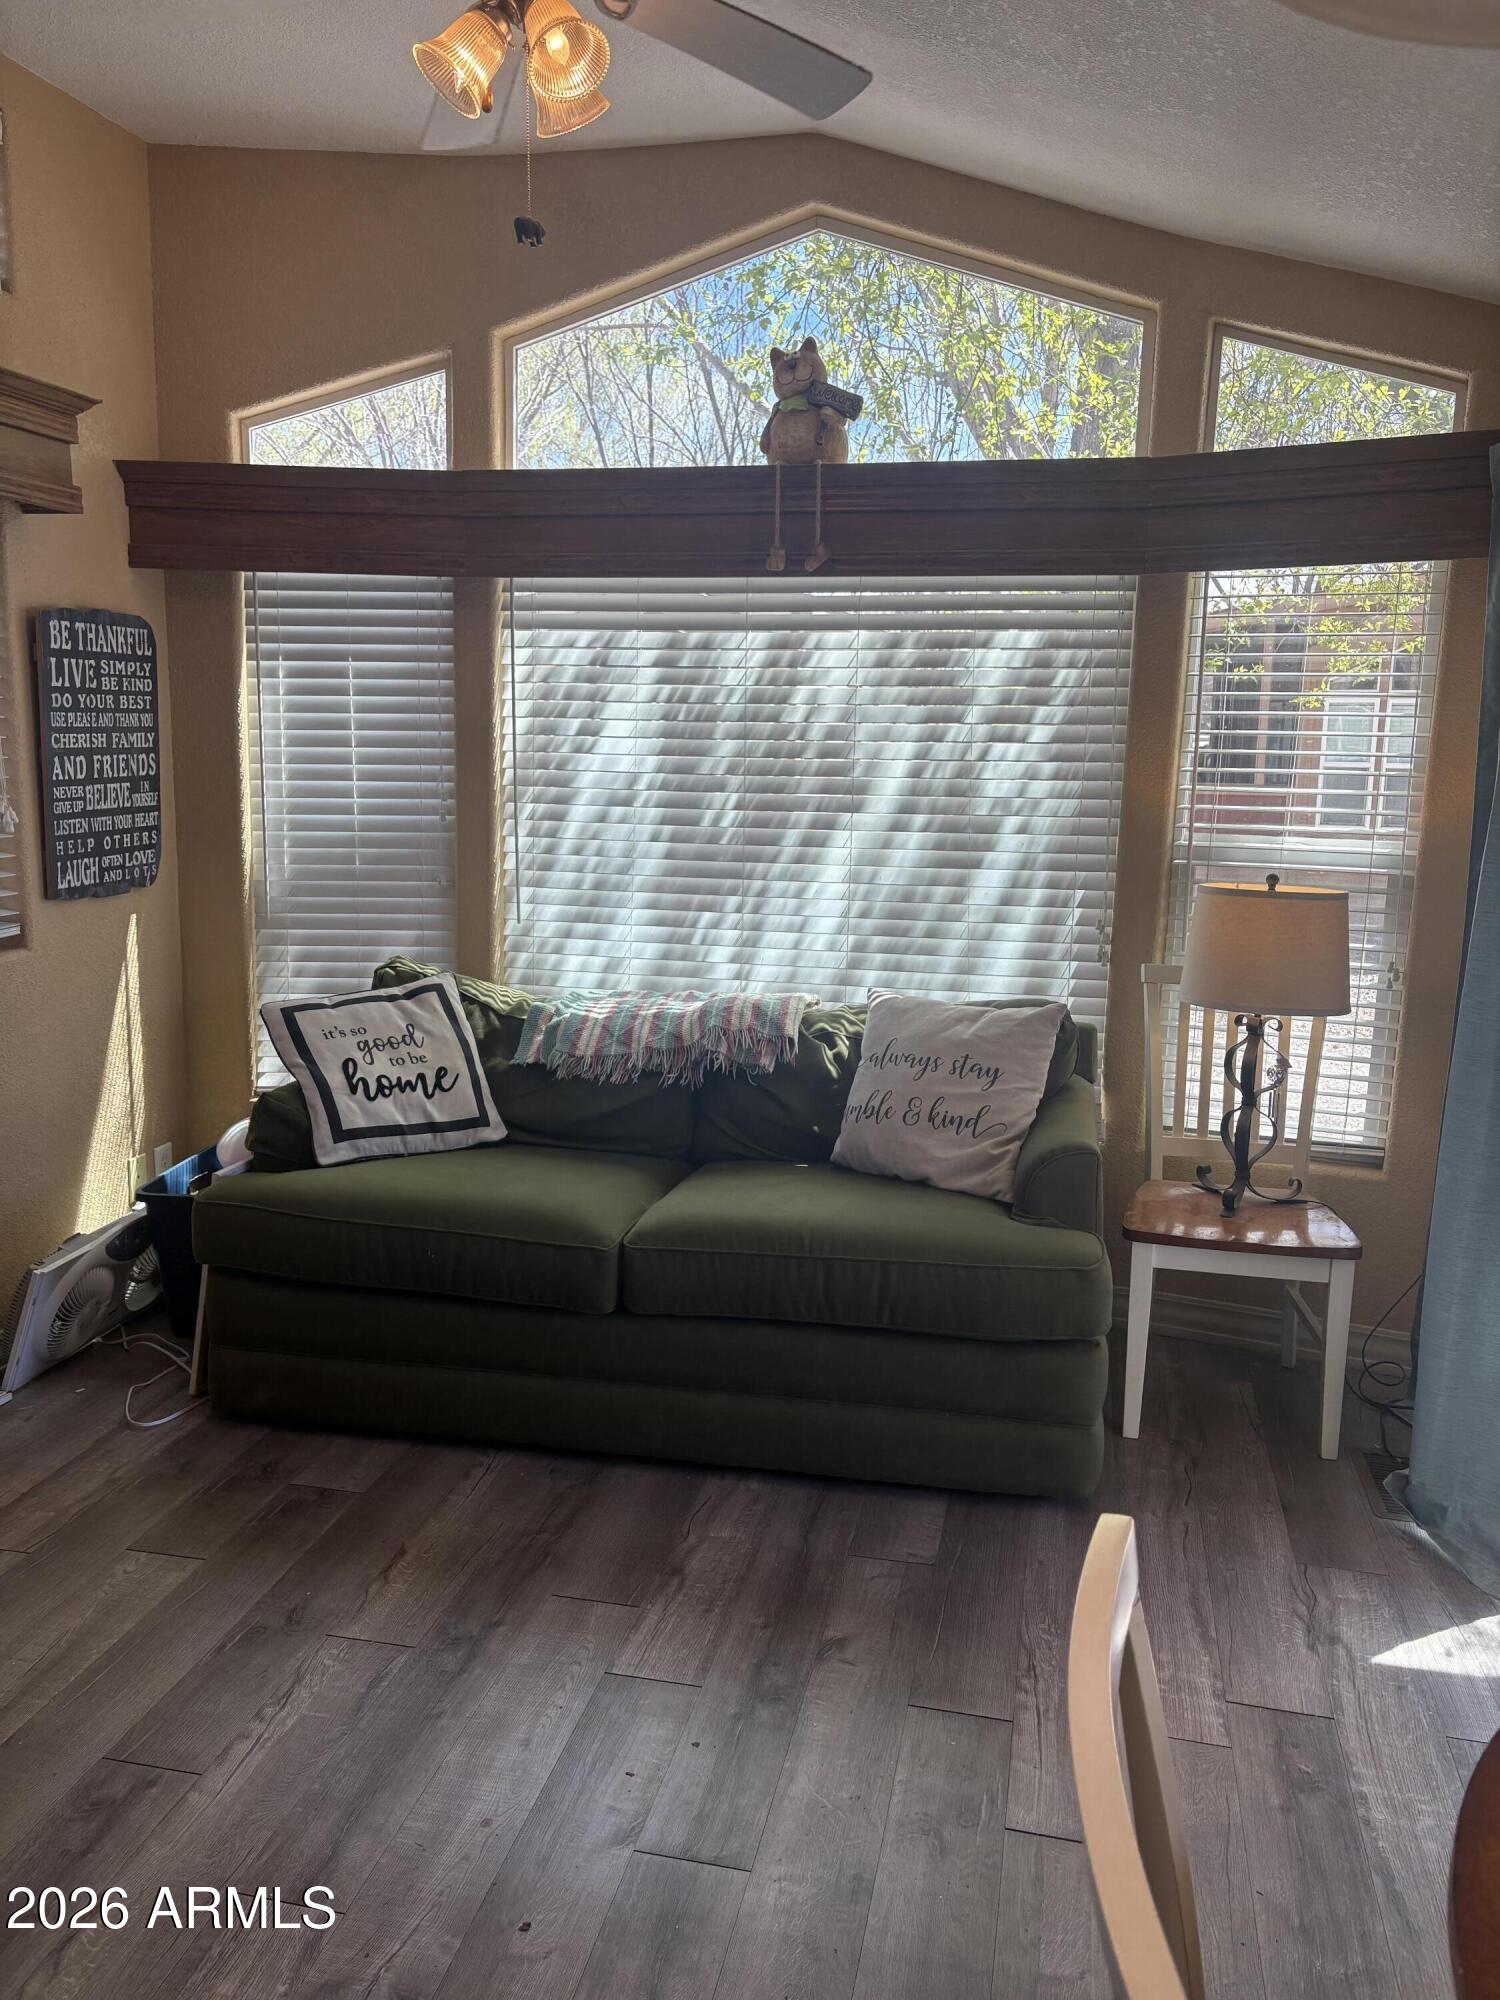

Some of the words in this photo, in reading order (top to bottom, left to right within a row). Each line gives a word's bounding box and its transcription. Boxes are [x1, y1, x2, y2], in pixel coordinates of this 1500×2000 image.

[49, 620, 71, 650] BE
[75, 622, 152, 656] THANKFUL
[50, 657, 97, 688] LIVE
[101, 660, 151, 676] SIMPLY
[101, 677, 118, 690] BE
[123, 678, 152, 692] KIND
[52, 693, 72, 707] DO
[78, 694, 114, 708] YOUR
[120, 695, 152, 709] BEST
[51, 712, 66, 727] USE
[68, 712, 97, 727] PLEASE
[98, 712, 113, 727] AND
[115, 713, 140, 727] THANK
[140, 713, 153, 727] YOU
[52, 733, 106, 748] CHERISH
[112, 732, 154, 748] FAMILY
[52, 755, 86, 780] AND
[93, 753, 155, 778] FRIENDS
[53, 785, 84, 799] NEVER
[140, 781, 149, 792] IN
[86, 782, 131, 810] BELIEVE
[132, 792, 158, 807] YOURSELF
[54, 801, 73, 814] GIVE
[74, 801, 84, 812] UP
[54, 818, 88, 835] LISTEN
[91, 816, 112, 832] WITH
[114, 814, 132, 829] YOUR
[135, 812, 158, 827] HEART
[56, 838, 95, 855] HELP
[103, 830, 157, 850] OTHERS
[102, 854, 123, 867] OFTEN
[125, 849, 155, 866] LOVE
[57, 857, 99, 889] LAUGH
[103, 869, 122, 882] AND
[126, 865, 156, 879] LOTS
[321, 1026, 346, 1040] it's
[350, 1027, 367, 1036] so
[357, 1024, 424, 1065] good
[389, 1057, 405, 1066] to
[408, 1052, 428, 1064] be
[858, 1038, 944, 1081] always
[949, 1053, 1006, 1091] stay
[342, 1057, 459, 1102] home
[845, 1090, 896, 1124] mble
[903, 1096, 922, 1126] &
[928, 1096, 1007, 1139] kind
